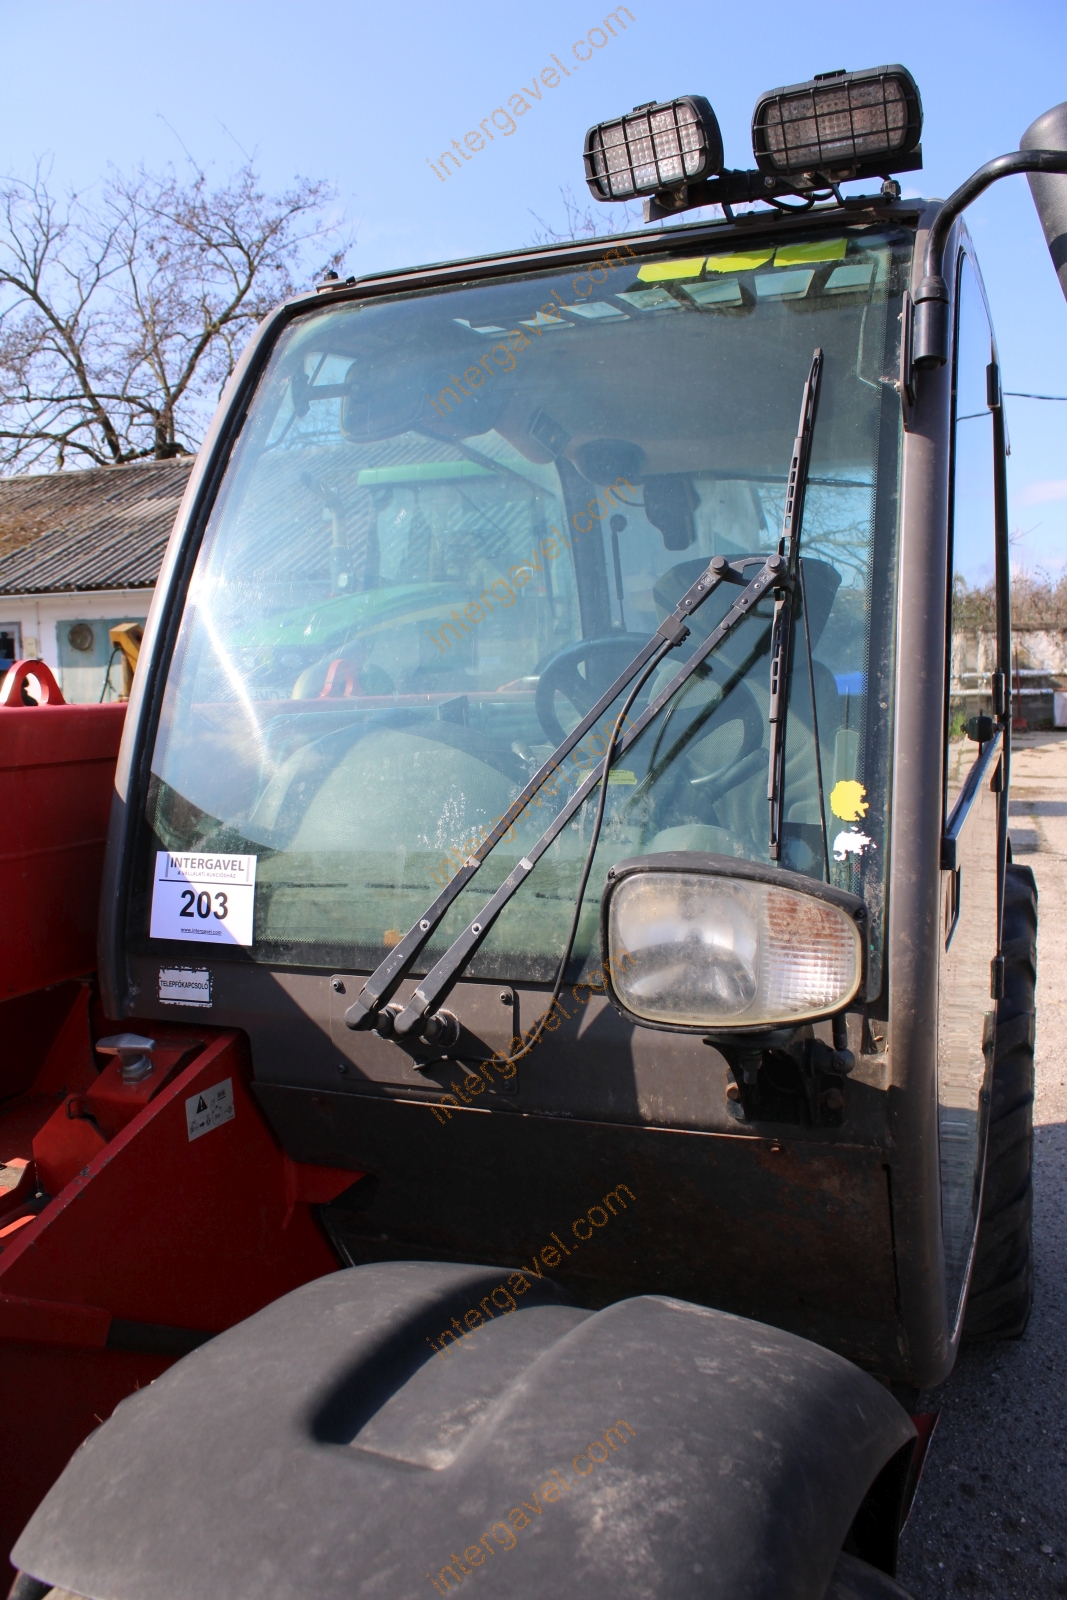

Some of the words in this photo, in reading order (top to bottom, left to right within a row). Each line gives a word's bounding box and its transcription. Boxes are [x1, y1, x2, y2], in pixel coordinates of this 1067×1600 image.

[171, 857, 244, 871] INTERGAVEL
[179, 890, 229, 919] 203
[181, 928, 222, 936] www.intergavel.com
